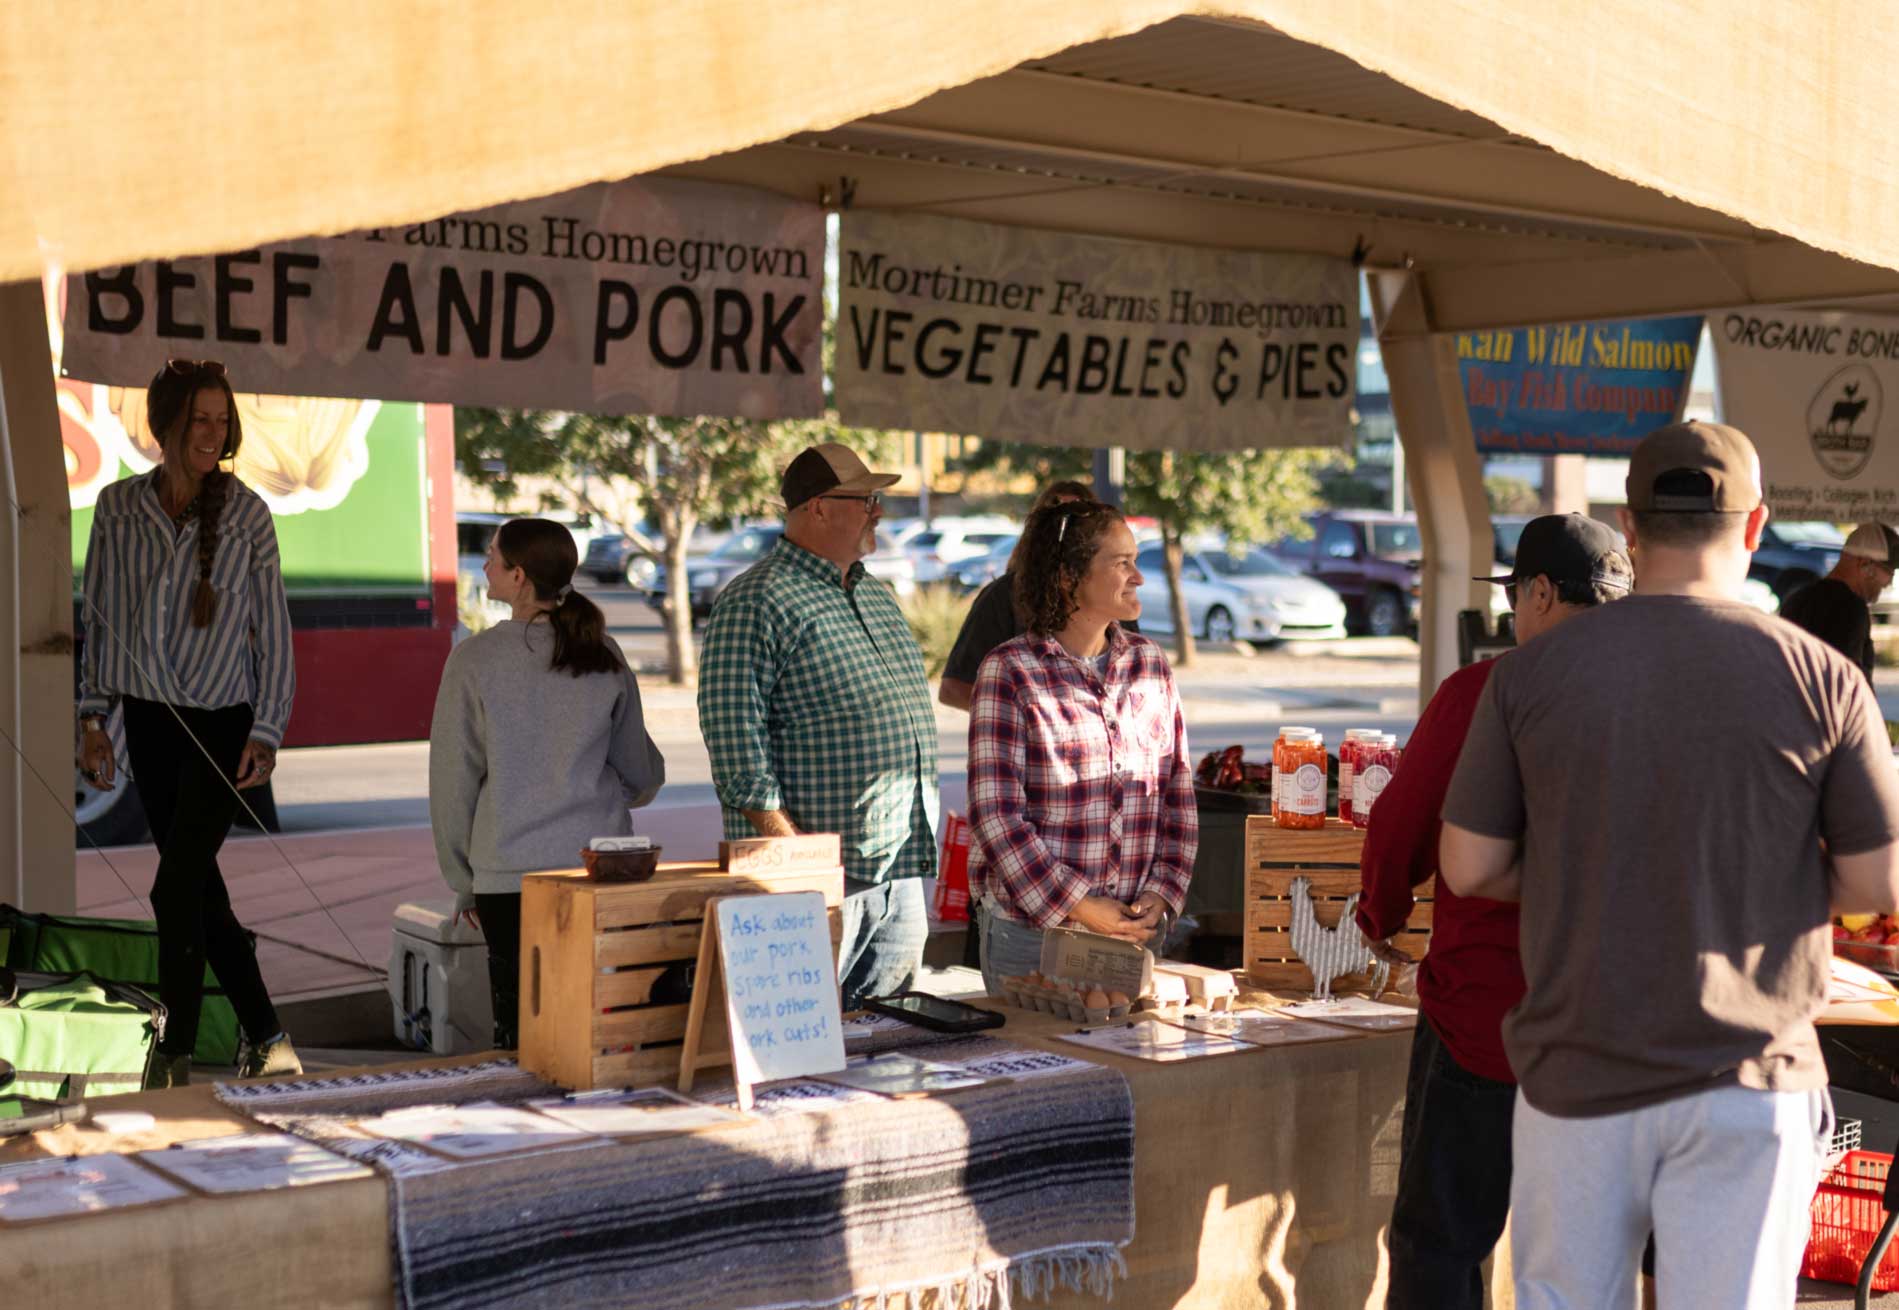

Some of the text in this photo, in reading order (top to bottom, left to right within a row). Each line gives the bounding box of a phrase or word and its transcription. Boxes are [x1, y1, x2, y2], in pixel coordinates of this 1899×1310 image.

[542, 216, 811, 282] Homegrown
[85, 251, 806, 375] BEEF AND PORK
[848, 251, 1347, 339] Mortimer Farms Homegrown
[1527, 324, 1587, 366] Wild
[1724, 314, 1842, 354] ORGANIC
[850, 305, 1348, 405] VEGETABLES & PIES
[1519, 371, 1567, 411] Fish
[734, 845, 784, 870] EGGS
[731, 910, 816, 936] Ask about
[768, 938, 813, 970] pork
[744, 996, 819, 1019] and other
[784, 1015, 829, 1042] cuts!
